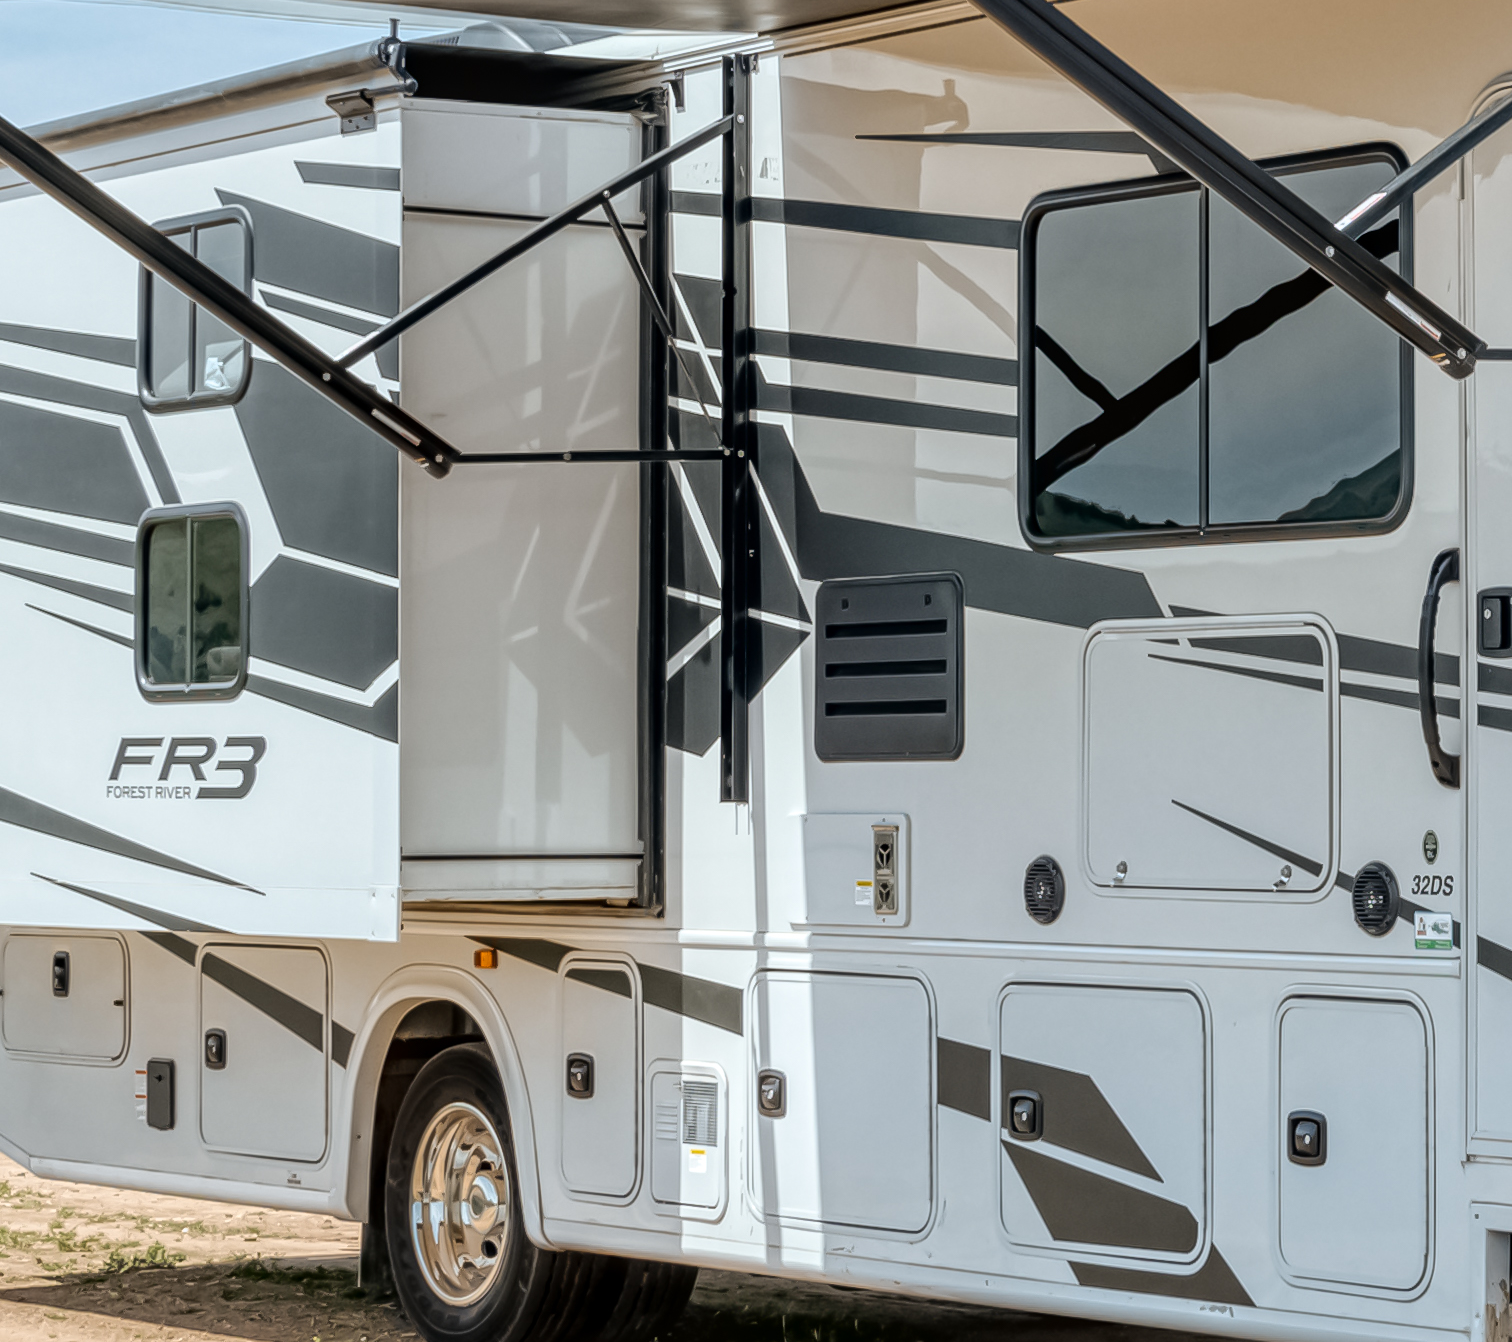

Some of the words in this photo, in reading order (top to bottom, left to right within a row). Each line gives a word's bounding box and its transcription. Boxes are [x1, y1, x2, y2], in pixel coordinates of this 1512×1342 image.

[108, 736, 267, 799] FR3
[106, 786, 153, 799] FOREST
[155, 786, 192, 799] RIVER
[1411, 874, 1454, 897] 32DS
